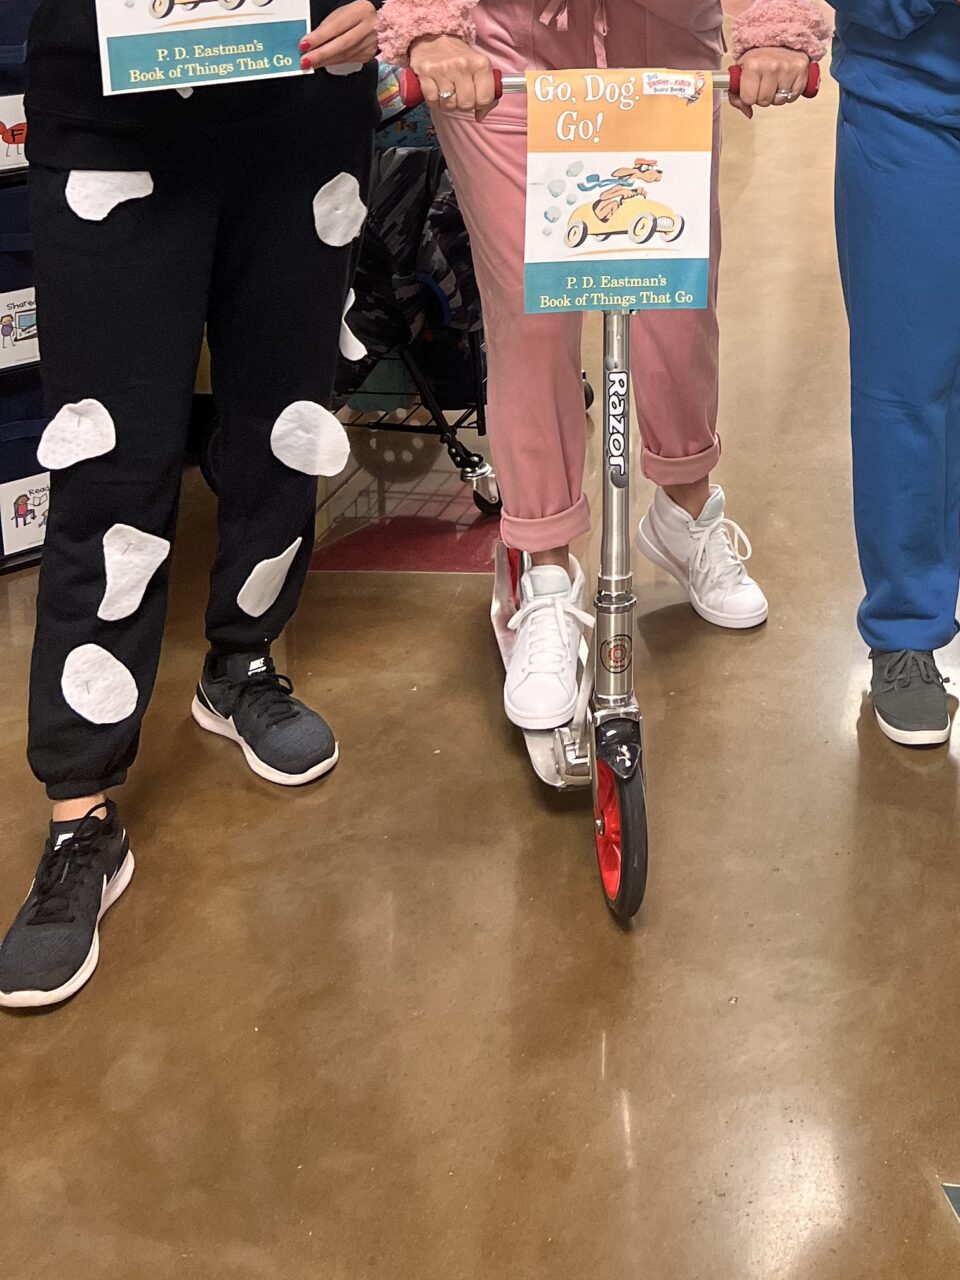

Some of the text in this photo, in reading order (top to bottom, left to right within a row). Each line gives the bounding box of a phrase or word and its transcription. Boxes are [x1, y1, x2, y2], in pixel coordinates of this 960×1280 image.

[156, 39, 264, 63] P. D. Eastman's
[129, 53, 293, 83] Book of Things That Go
[534, 74, 641, 111] Go, Dog.
[556, 110, 605, 144] Go!
[566, 274, 667, 290] P. D. Eastman's
[539, 290, 694, 308] Book of Things That Go
[608, 371, 628, 476] Razor
[28, 483, 50, 496] Read
